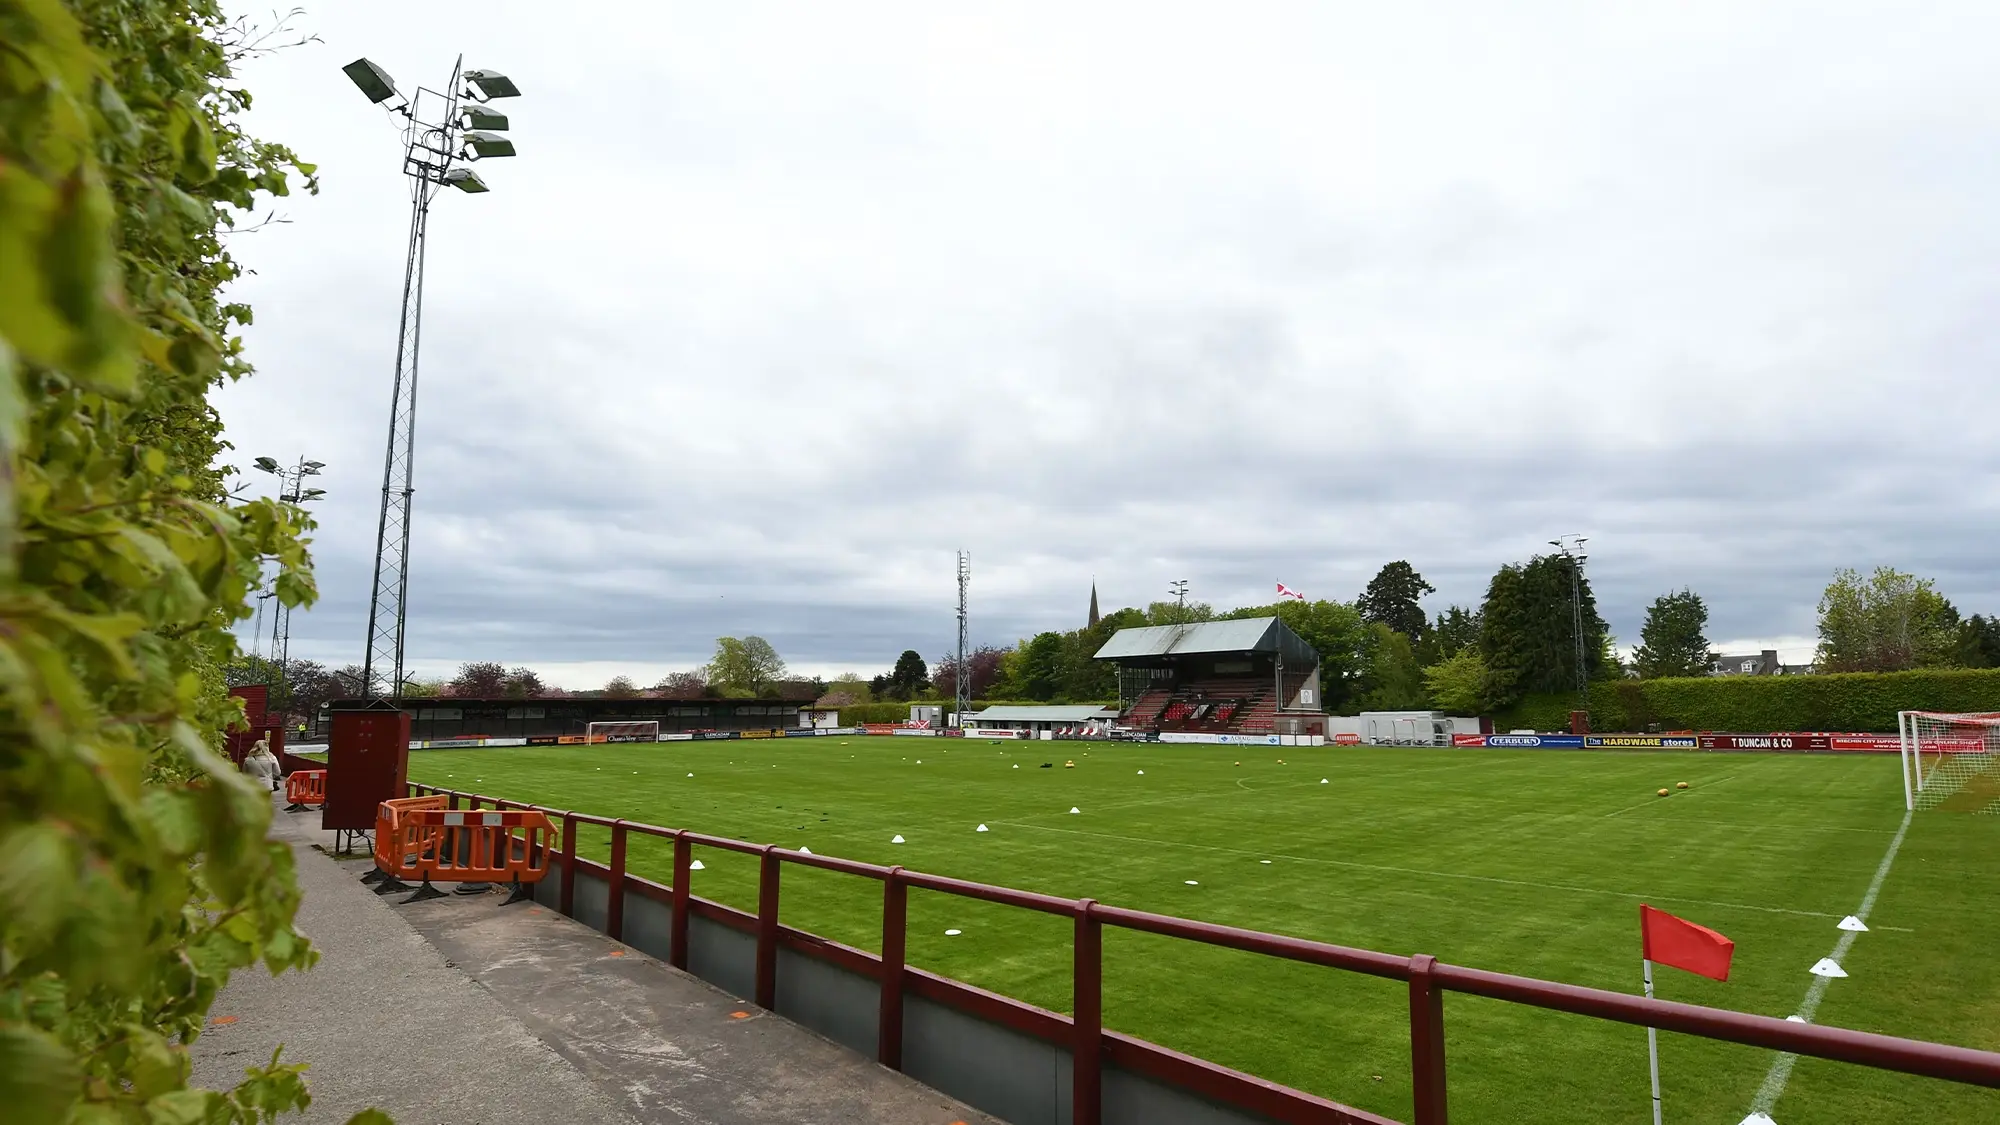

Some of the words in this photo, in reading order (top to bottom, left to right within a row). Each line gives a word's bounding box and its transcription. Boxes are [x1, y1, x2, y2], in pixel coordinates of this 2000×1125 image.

[1603, 738, 1661, 746] HARDWARE
[1731, 738, 1737, 748] T
[1739, 738, 1771, 748] DUNCAN
[1773, 738, 1779, 748] &
[1781, 738, 1793, 748] CO
